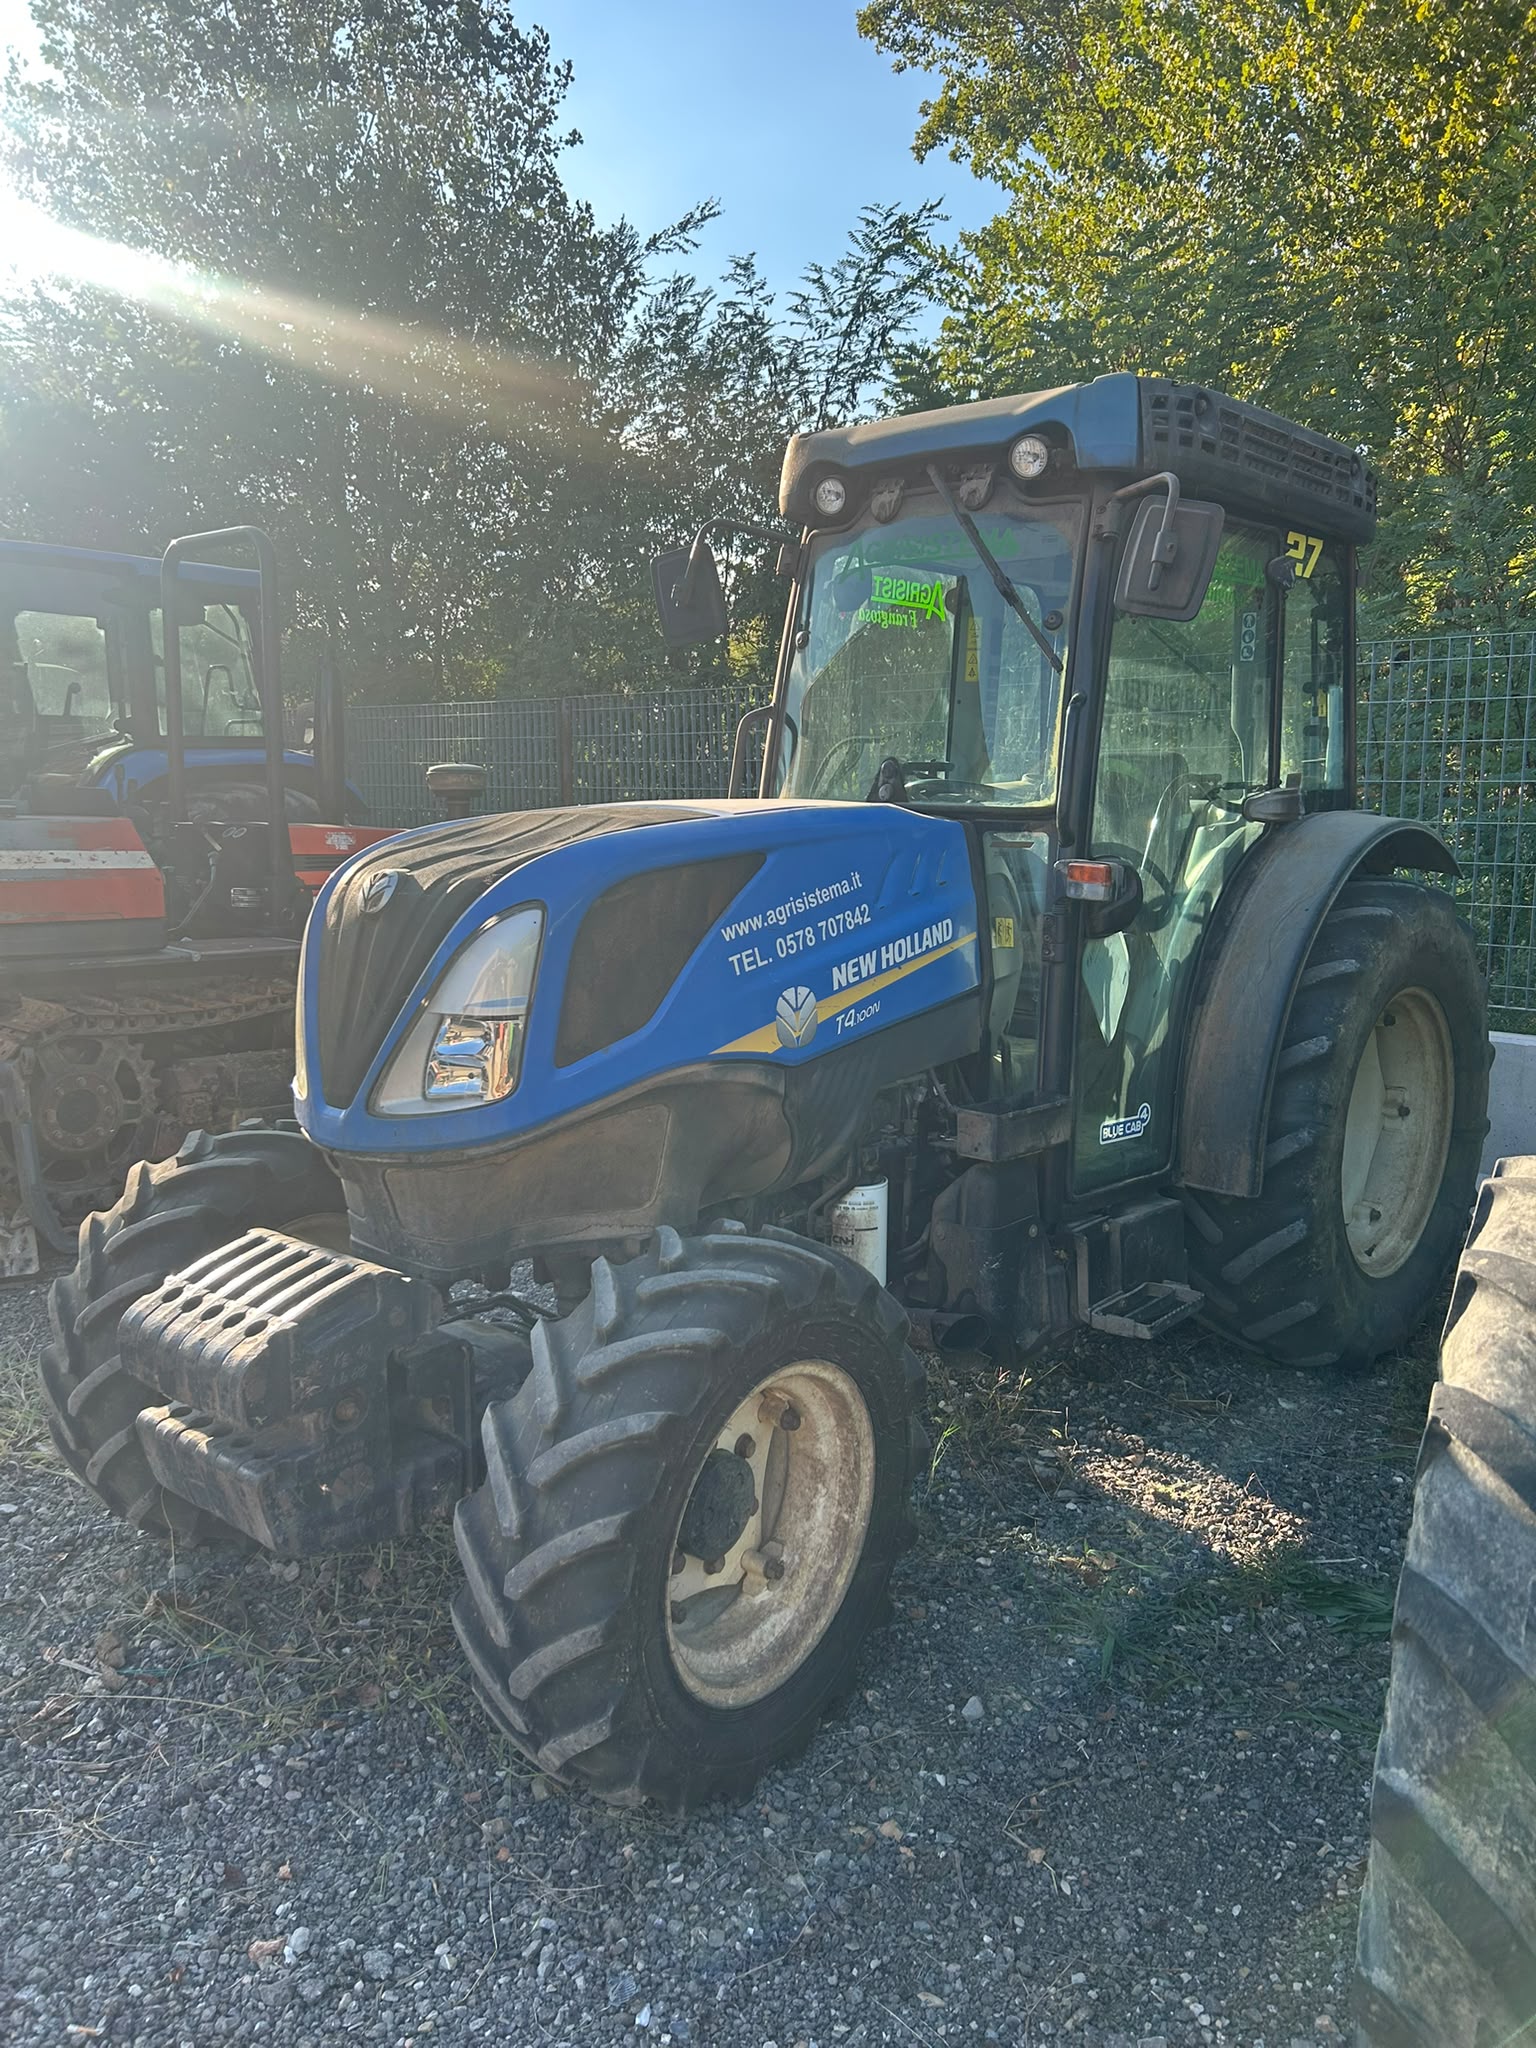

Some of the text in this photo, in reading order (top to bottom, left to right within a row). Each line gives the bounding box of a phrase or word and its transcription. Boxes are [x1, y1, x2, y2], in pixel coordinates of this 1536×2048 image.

[1286, 531, 1323, 578] 27
[720, 871, 863, 942] www.agrisistema.it
[728, 903, 871, 977] TEL. 0578 707842
[831, 918, 953, 991] NEW HOLLAND
[1102, 1107, 1148, 1139] BLUE CAB 4
